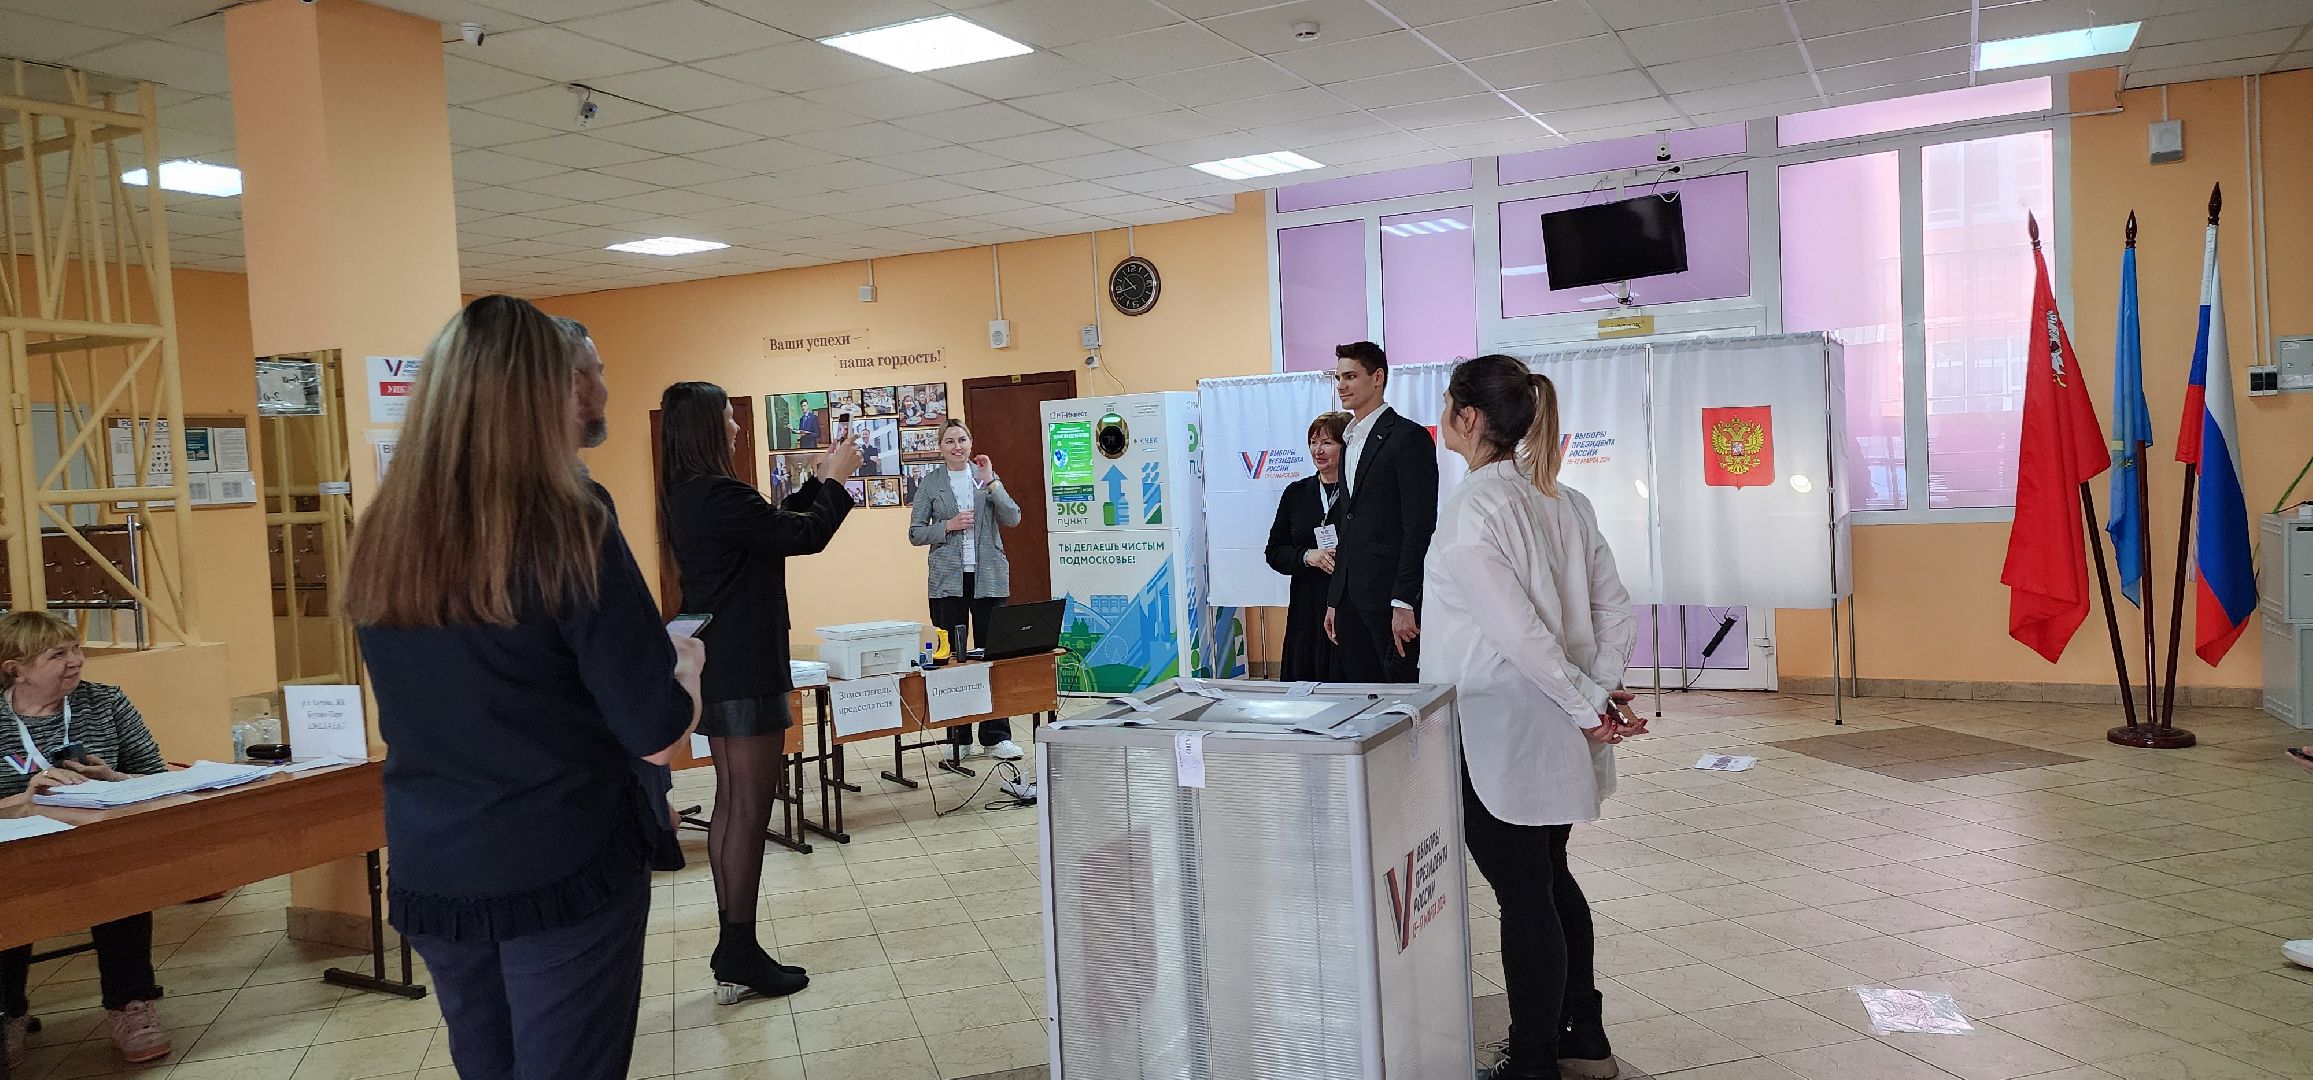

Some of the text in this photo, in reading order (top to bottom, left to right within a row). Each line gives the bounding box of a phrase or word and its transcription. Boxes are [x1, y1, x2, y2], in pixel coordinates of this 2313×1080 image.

[770, 338, 803, 351] Ваши
[806, 334, 851, 352] успехи
[839, 350, 941, 369] наша гордость!
[1575, 431, 1607, 439] ВЫБОРЫ
[1572, 439, 1615, 448] ПРЕЗИДЕНТА
[1270, 449, 1297, 457] ВЫБОРЫ
[1569, 449, 1598, 457] РОССИИ
[1057, 502, 1088, 516] ЭКО
[1059, 541, 1165, 553] ТЫ ДЕЛАЕШЬ ЧИСТЫМ
[1059, 555, 1136, 566] ПОДМОСКОВЬЕ!
[1416, 826, 1442, 863] ВЫБОРЫ
[1415, 843, 1448, 888] ПРЕЗИДЕНТА
[1413, 878, 1436, 917] РОССИИ
